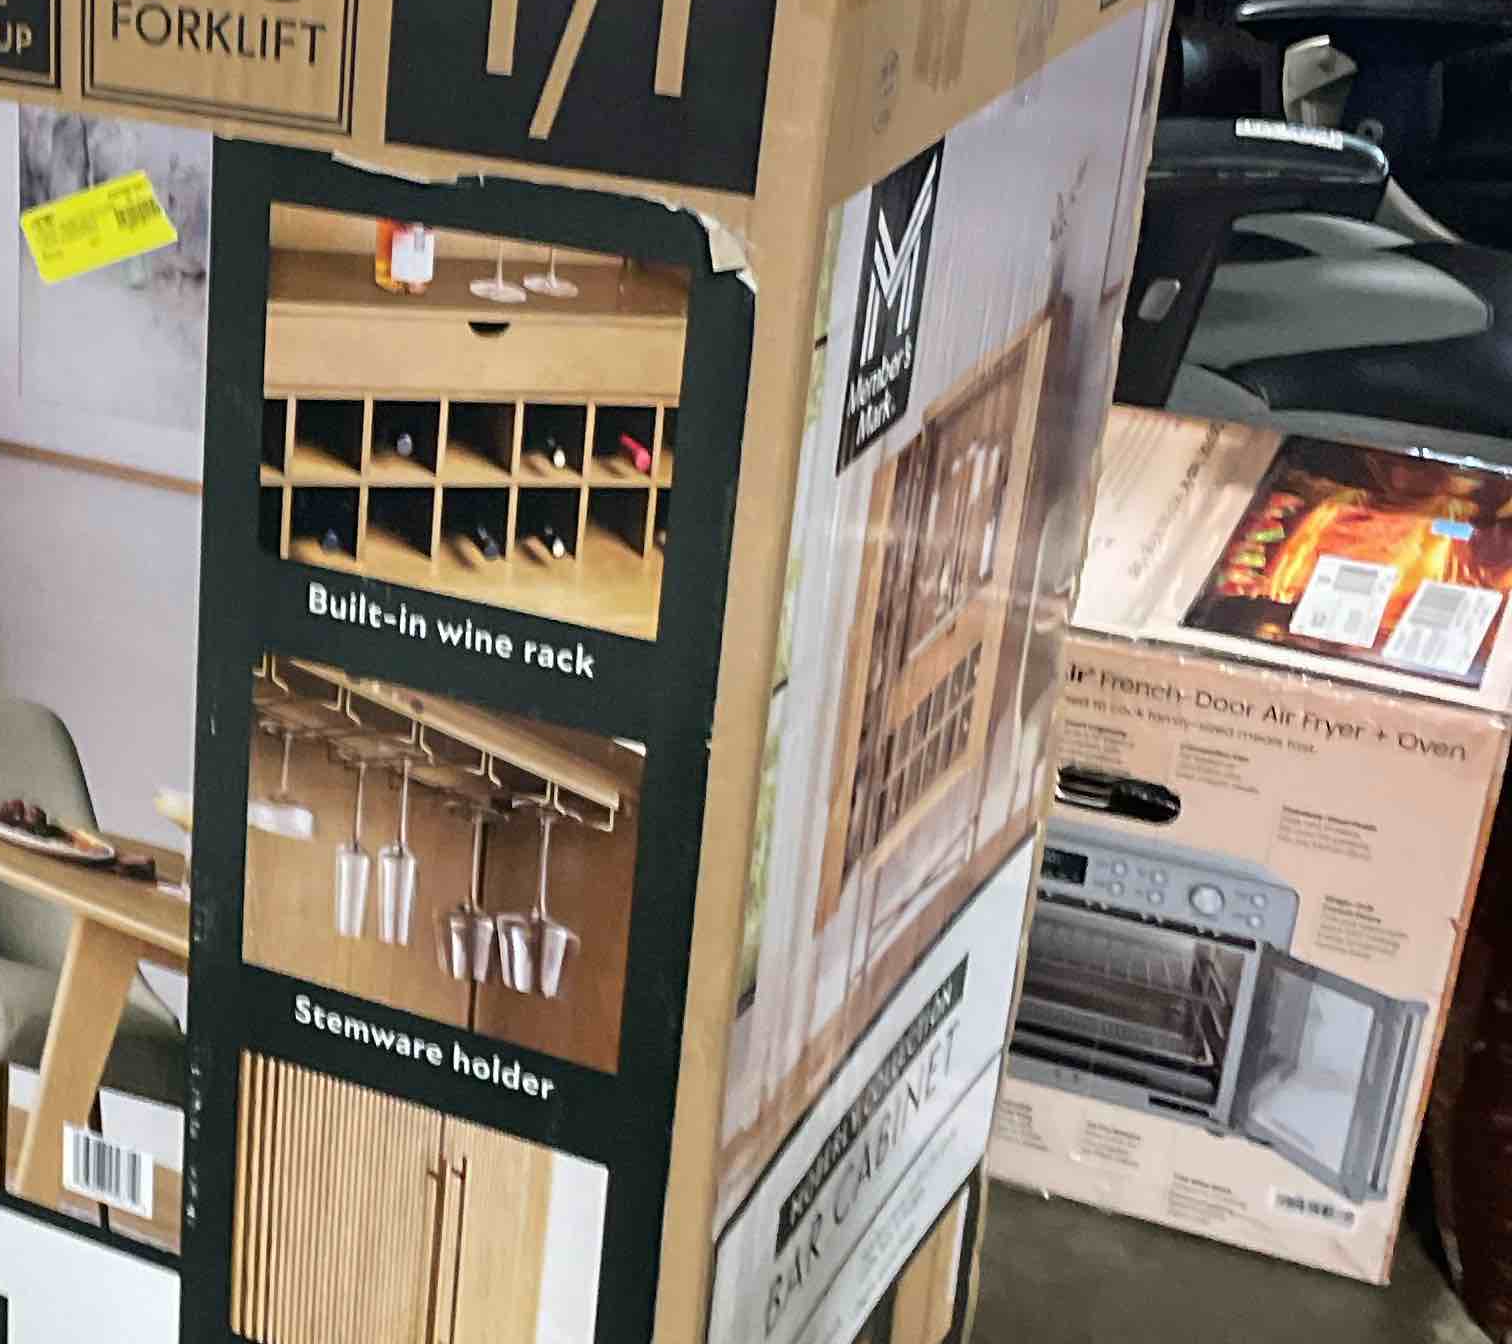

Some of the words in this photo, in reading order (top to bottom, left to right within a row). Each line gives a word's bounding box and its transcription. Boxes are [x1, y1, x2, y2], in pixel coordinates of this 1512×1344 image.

[308, 581, 428, 641] Built-in
[437, 619, 513, 661] wine
[523, 640, 594, 678] rack
[1195, 690, 1255, 718] Door
[1262, 702, 1296, 724] Air
[1302, 713, 1365, 743] Fryer
[1397, 731, 1467, 762] Oven
[294, 994, 443, 1068] Stemware
[452, 1041, 555, 1102] holder
